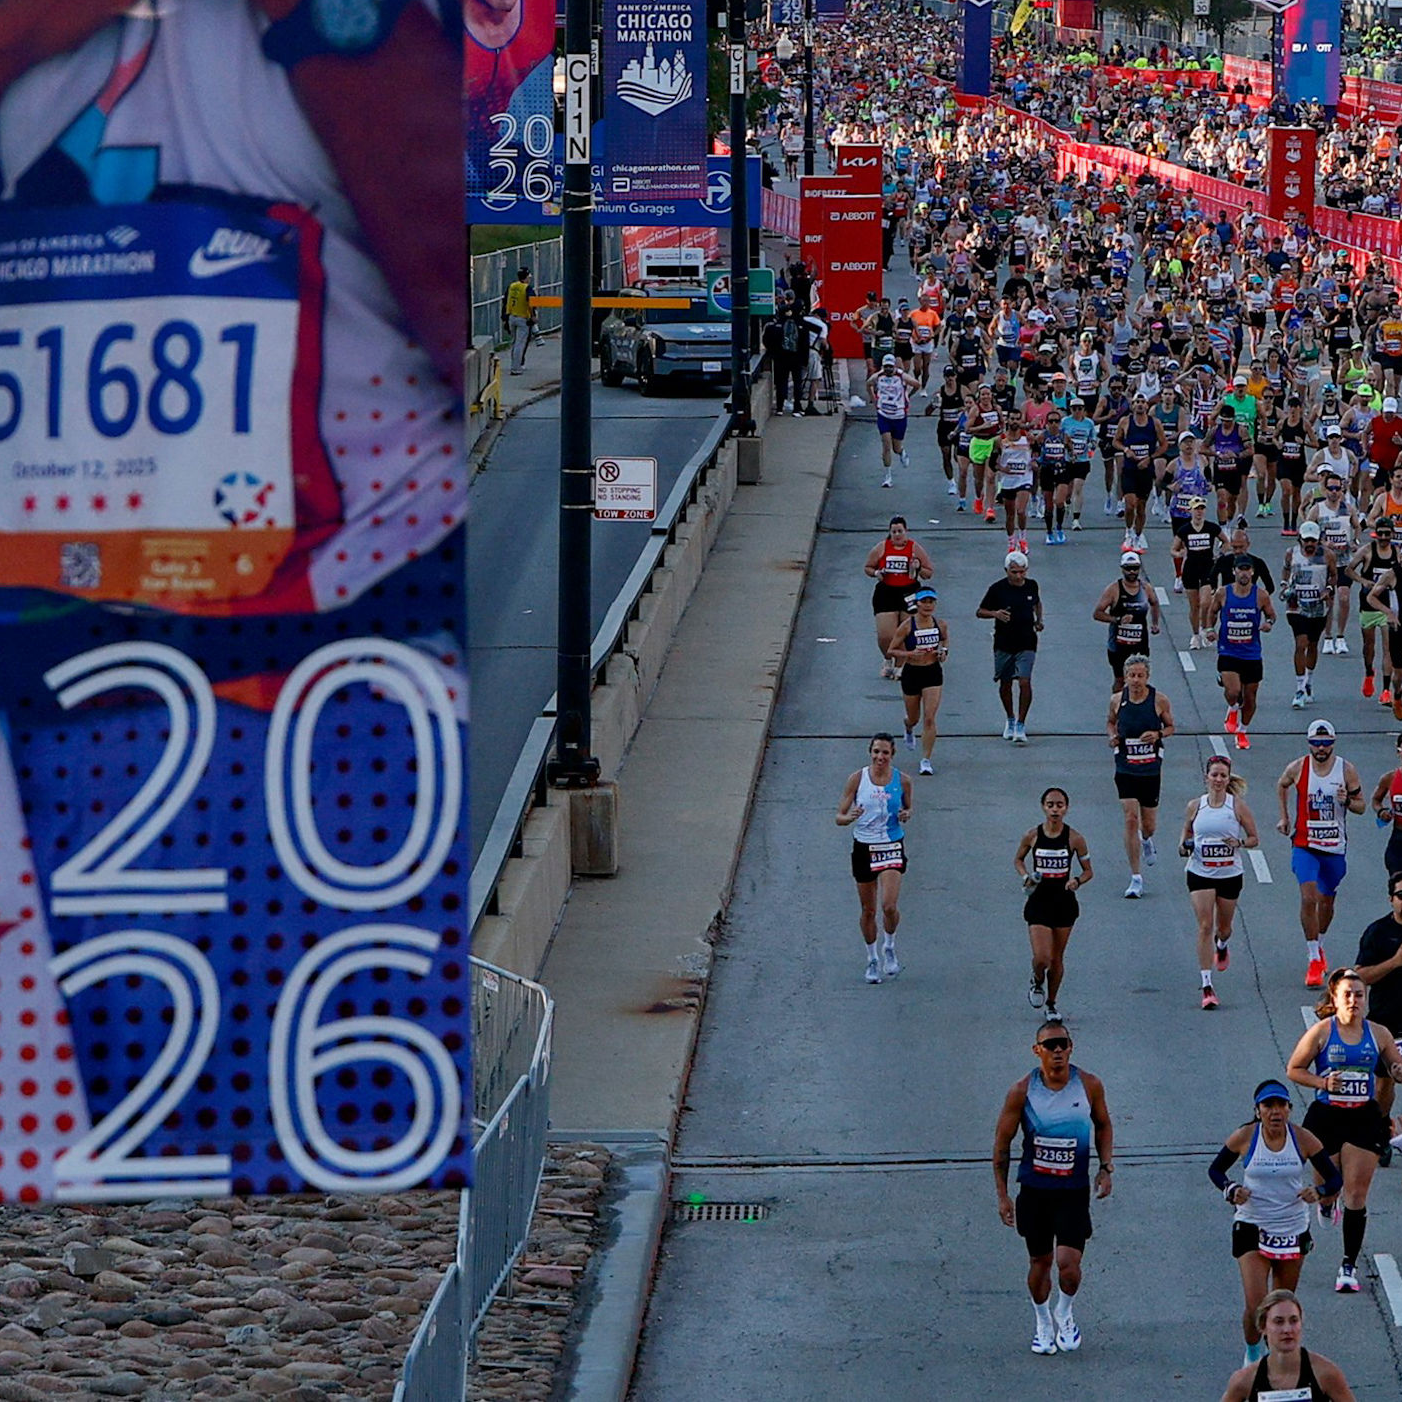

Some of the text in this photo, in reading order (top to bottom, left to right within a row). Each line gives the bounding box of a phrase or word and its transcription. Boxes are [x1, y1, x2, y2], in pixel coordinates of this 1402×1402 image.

[1197, 4, 1208, 12] 30
[617, 13, 693, 29] CHICAGO
[781, 11, 802, 24] 26
[617, 30, 692, 42] MARATHON
[732, 49, 743, 90] C11
[569, 59, 587, 160] C11N
[489, 113, 554, 158] 20
[842, 157, 878, 167] KIA
[612, 164, 700, 175] chicagomarathon.com
[488, 158, 553, 203] 26
[629, 203, 675, 215] Garages
[841, 212, 876, 221] ABBOTT
[51, 250, 155, 278] MARATHON
[842, 262, 877, 271] ABBOTT
[13, 460, 76, 480] October
[598, 510, 649, 518] TOW ZONE
[43, 636, 463, 916] 20
[48, 923, 464, 1198] 26
[1035, 1148, 1076, 1162] D23635
